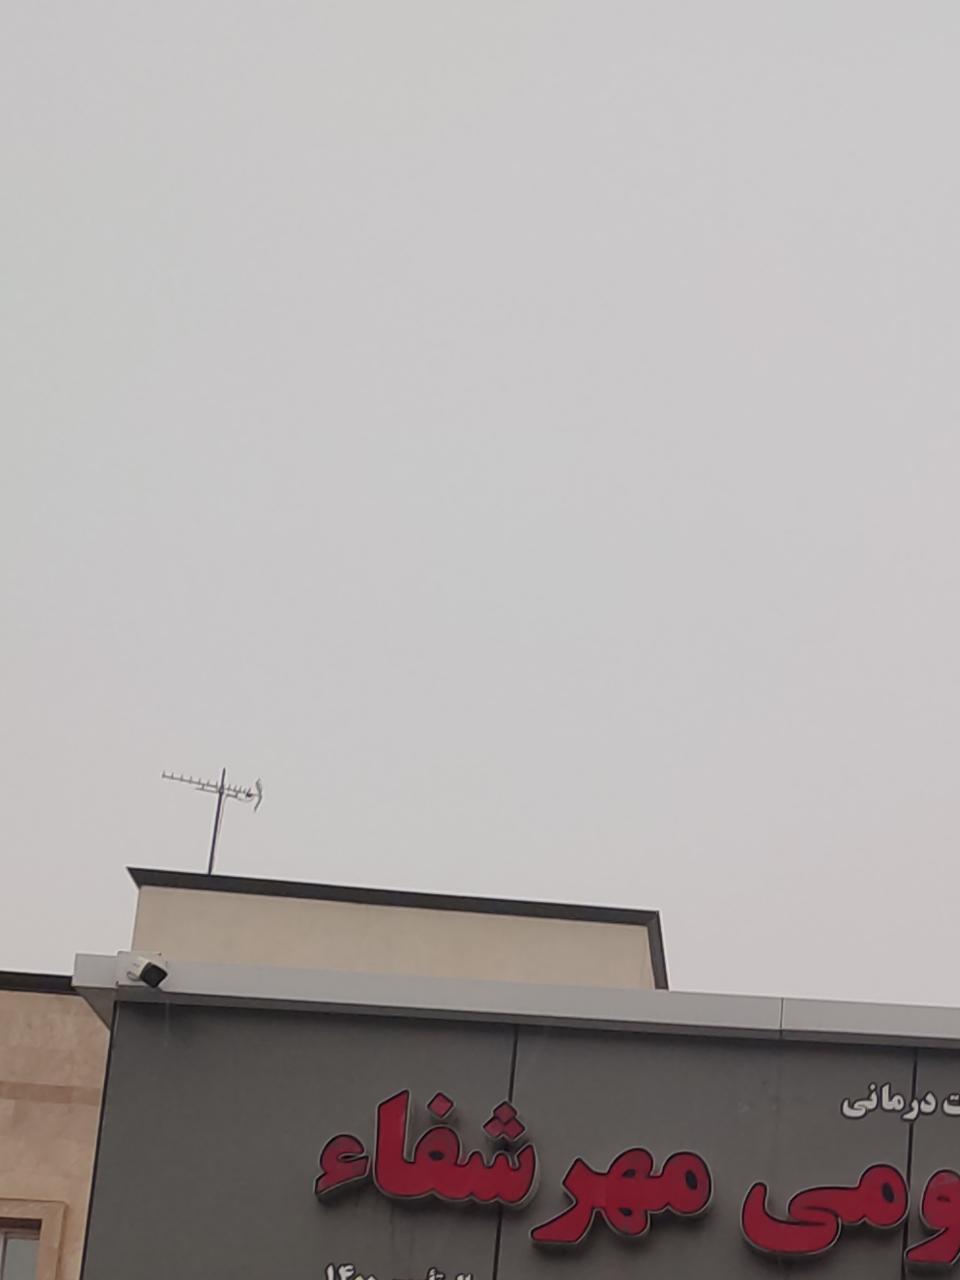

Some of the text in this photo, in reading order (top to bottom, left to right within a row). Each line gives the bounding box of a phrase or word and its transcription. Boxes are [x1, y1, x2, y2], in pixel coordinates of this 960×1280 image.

[315, 1089, 536, 1206] شفاء
[842, 1083, 937, 1120] درمانی
[530, 1146, 712, 1245] مهر
